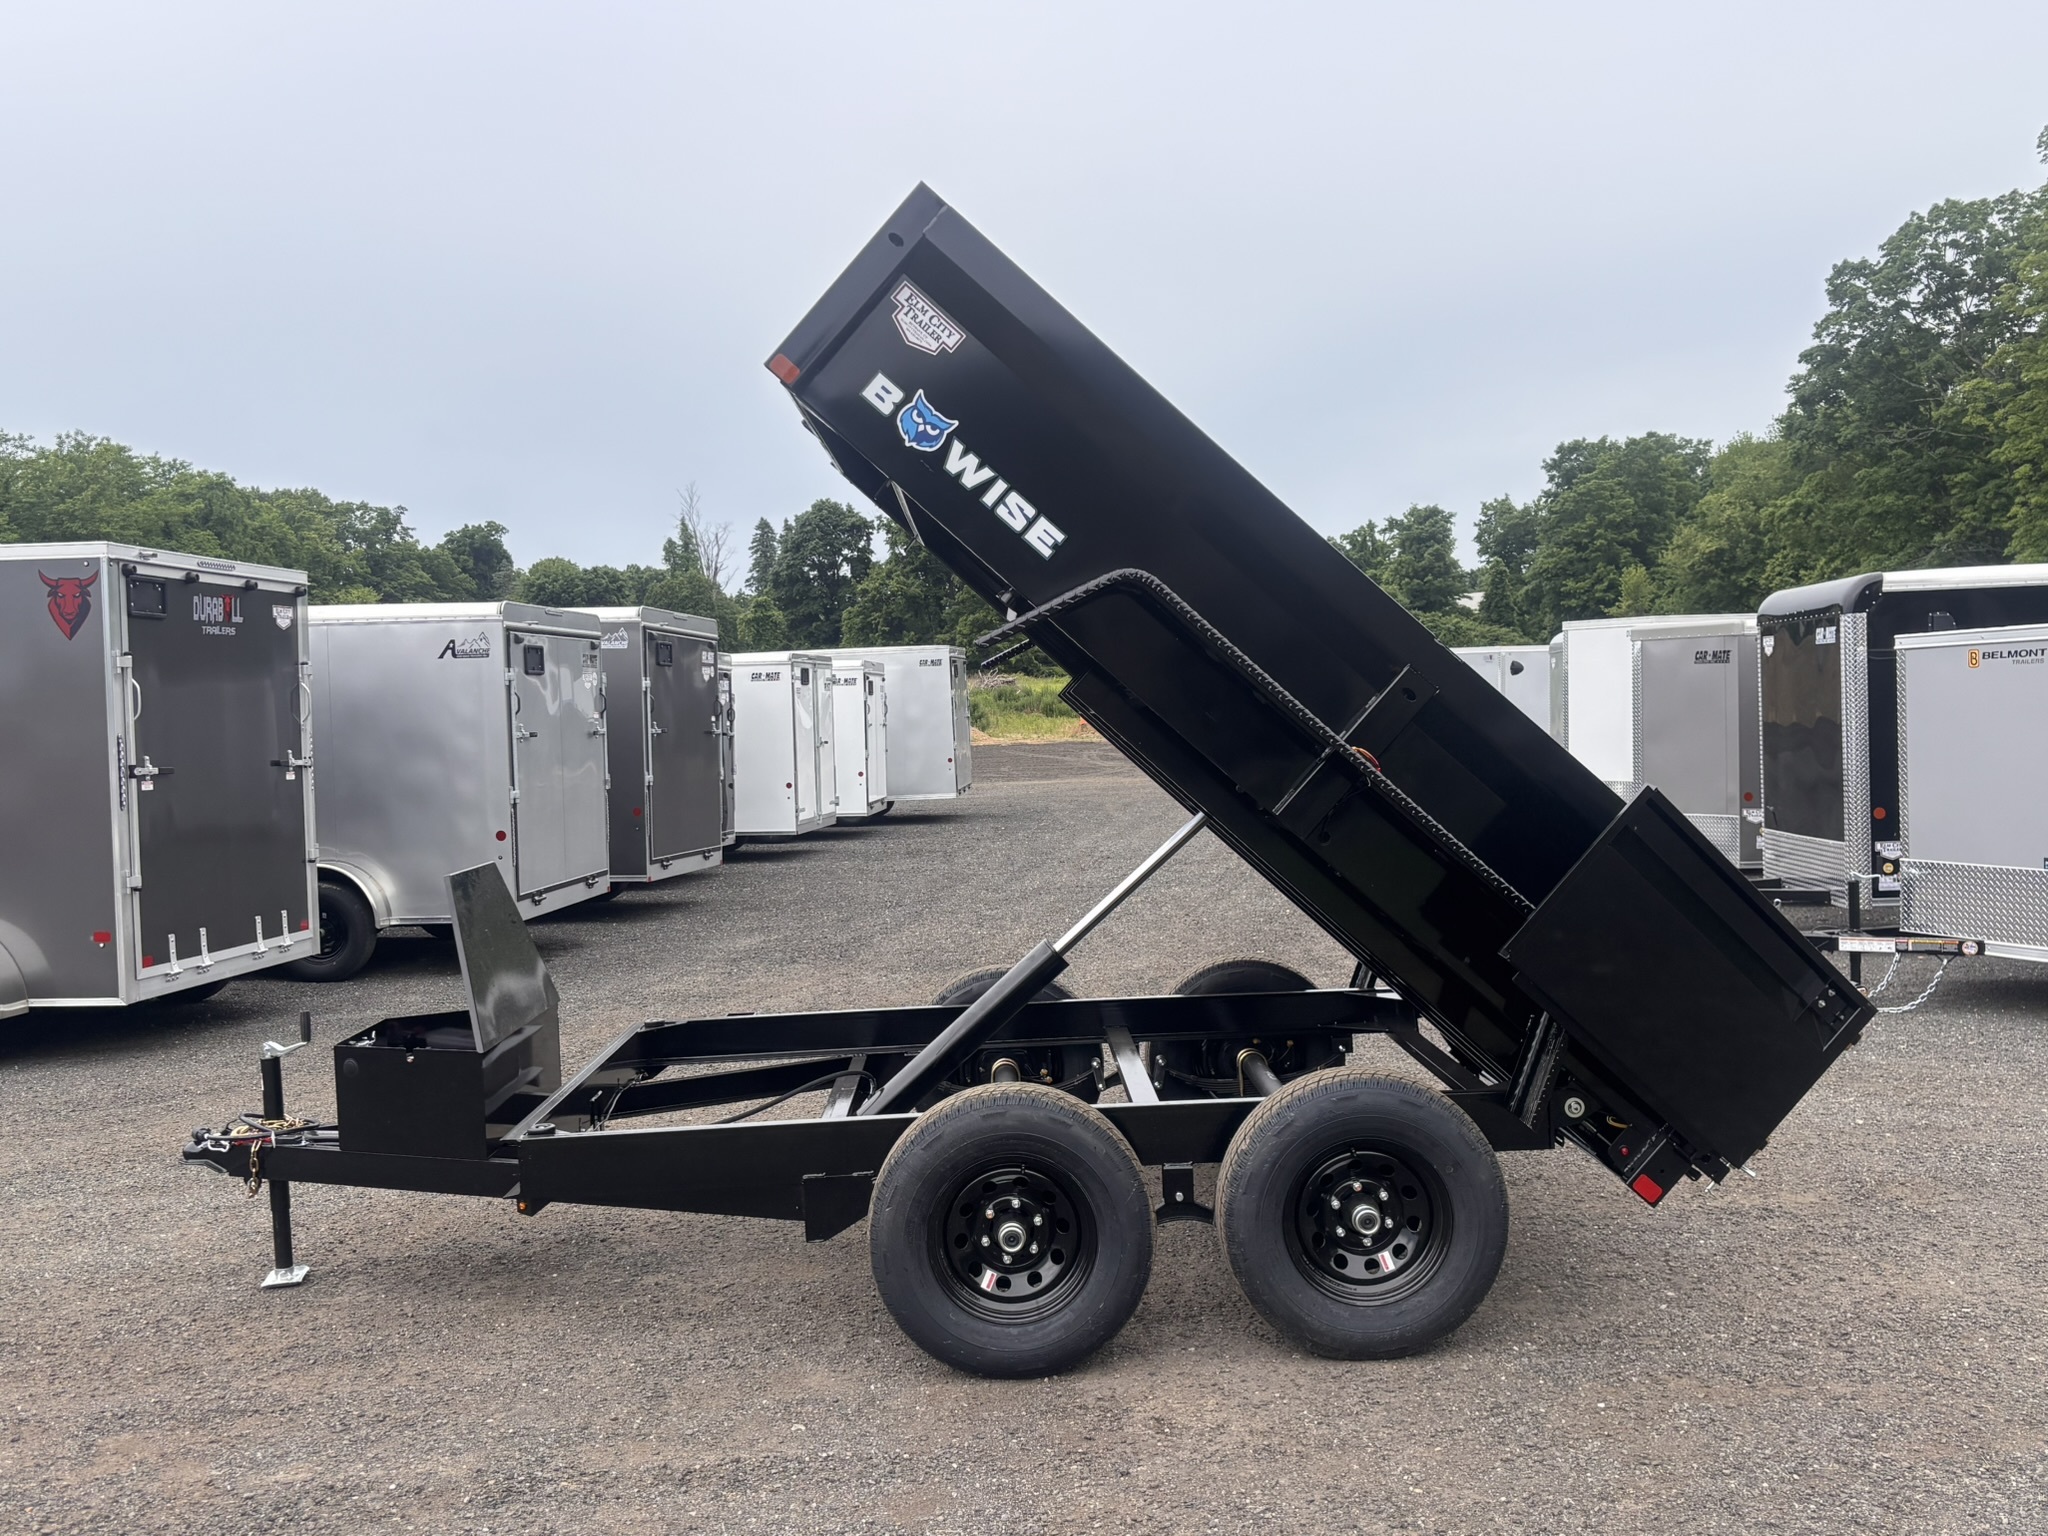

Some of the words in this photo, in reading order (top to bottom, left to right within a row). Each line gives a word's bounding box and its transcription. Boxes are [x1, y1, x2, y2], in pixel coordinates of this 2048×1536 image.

[903, 305, 942, 344] TRAILER
[904, 292, 930, 317] ELM
[928, 314, 956, 339] CITY
[202, 626, 236, 635] TRAILERS
[438, 639, 491, 659] AVALANCHE
[1982, 648, 2047, 660] BELMONT
